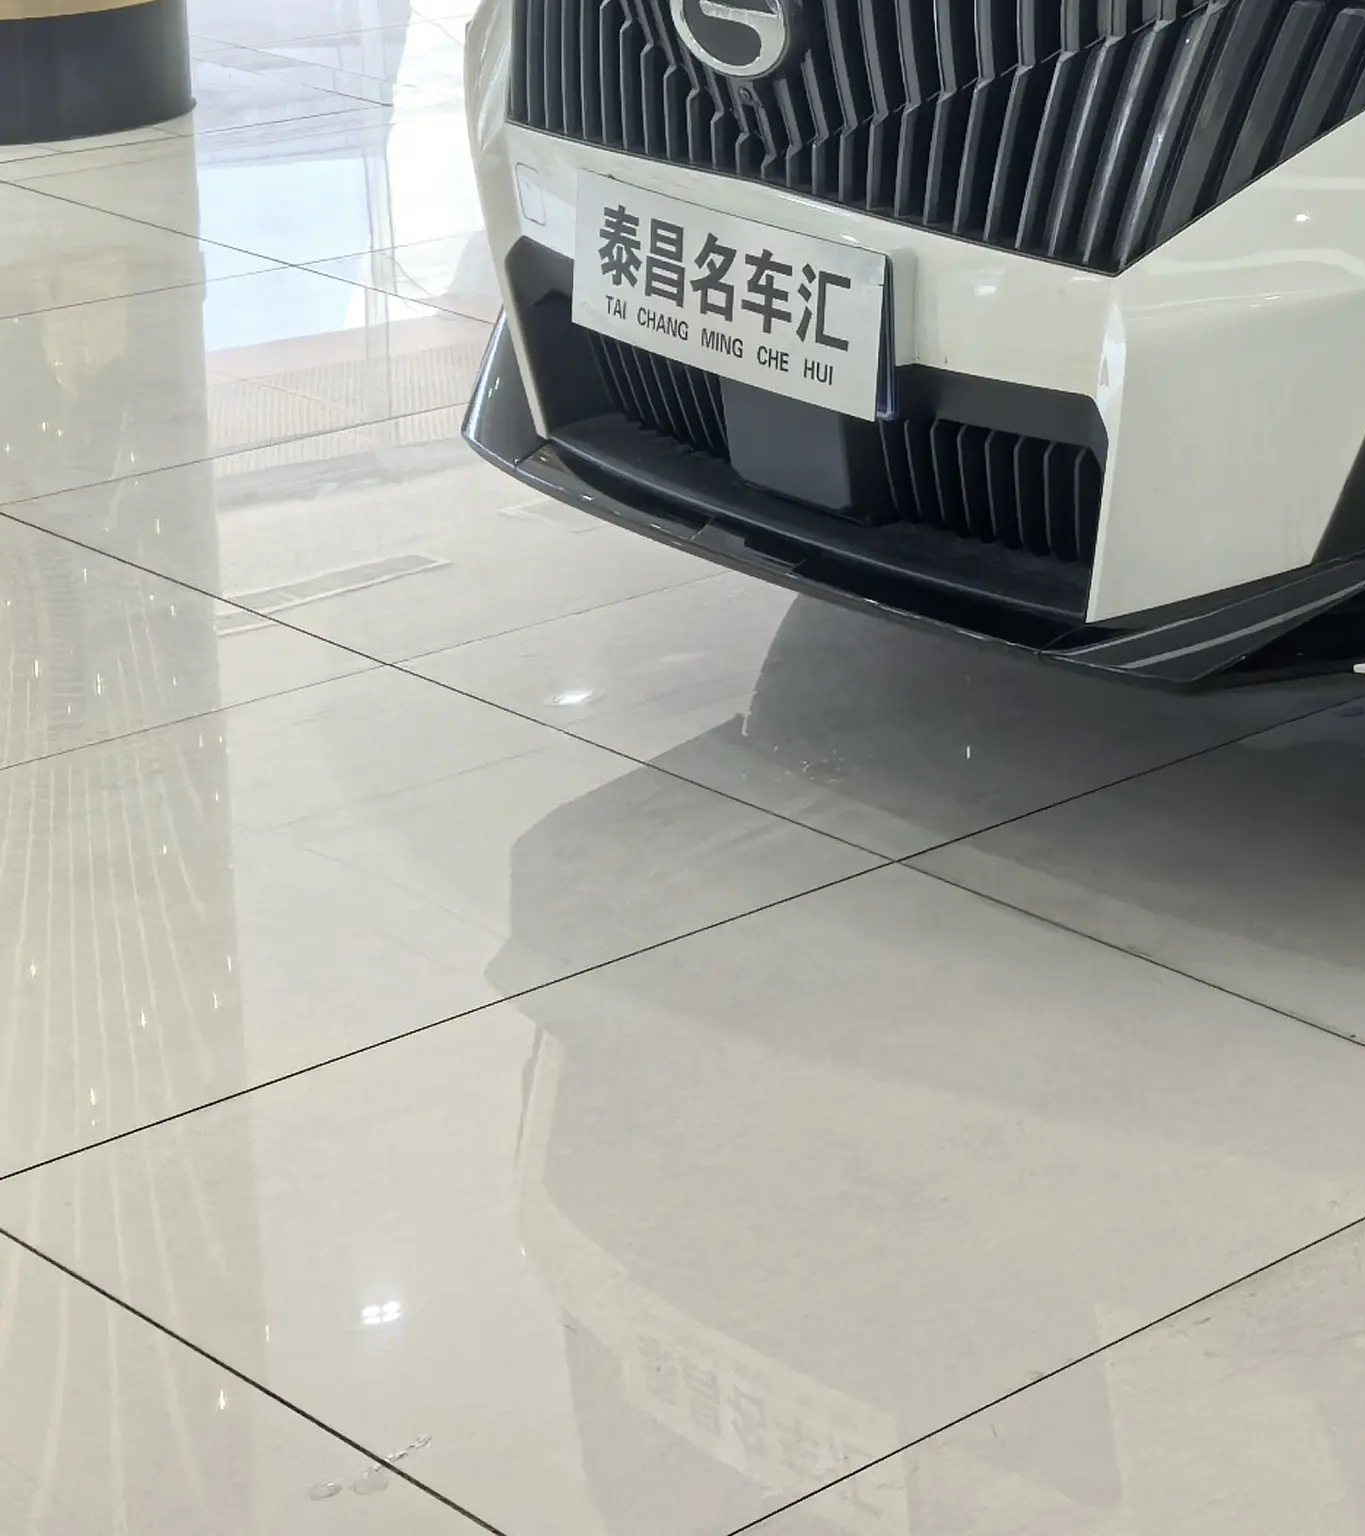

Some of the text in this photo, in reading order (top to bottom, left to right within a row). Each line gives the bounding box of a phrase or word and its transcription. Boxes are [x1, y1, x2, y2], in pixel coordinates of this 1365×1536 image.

[598, 204, 852, 353] 泰昌名车汇
[605, 295, 834, 386] TAI CHANG MING CHE HUI
